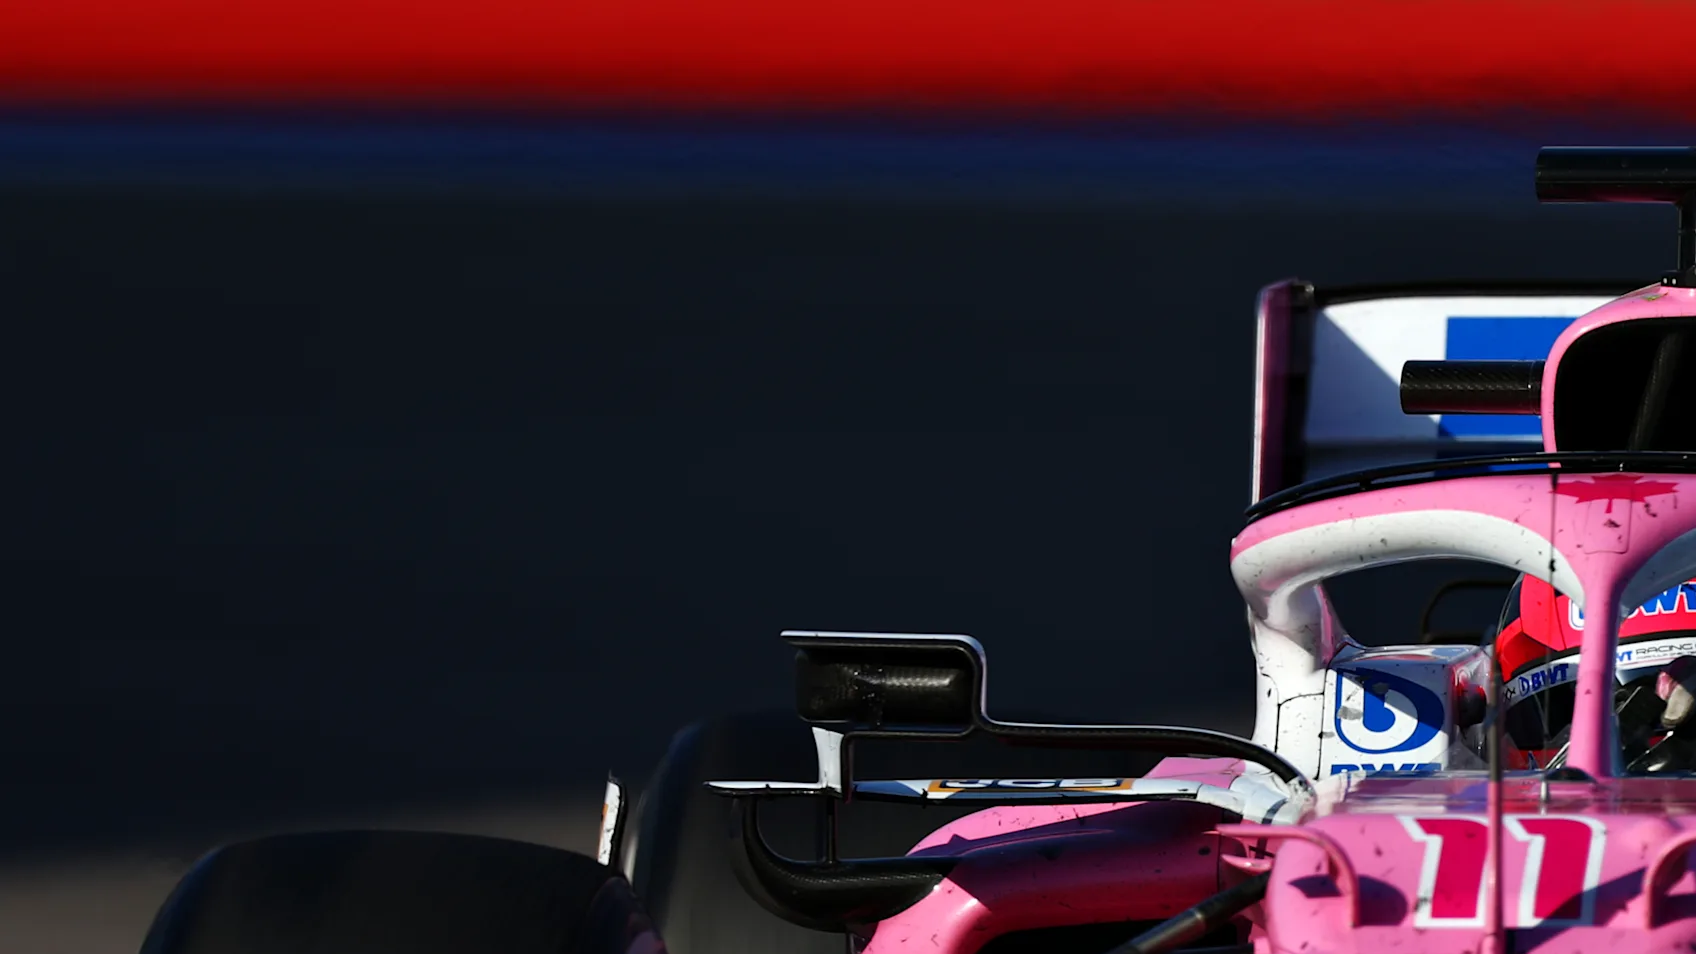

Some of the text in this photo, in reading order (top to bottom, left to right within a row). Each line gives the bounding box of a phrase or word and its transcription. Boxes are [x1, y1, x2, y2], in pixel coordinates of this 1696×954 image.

[1635, 643, 1693, 656] RACING
[1531, 663, 1570, 691] BWT
[1395, 813, 1607, 929] 11
